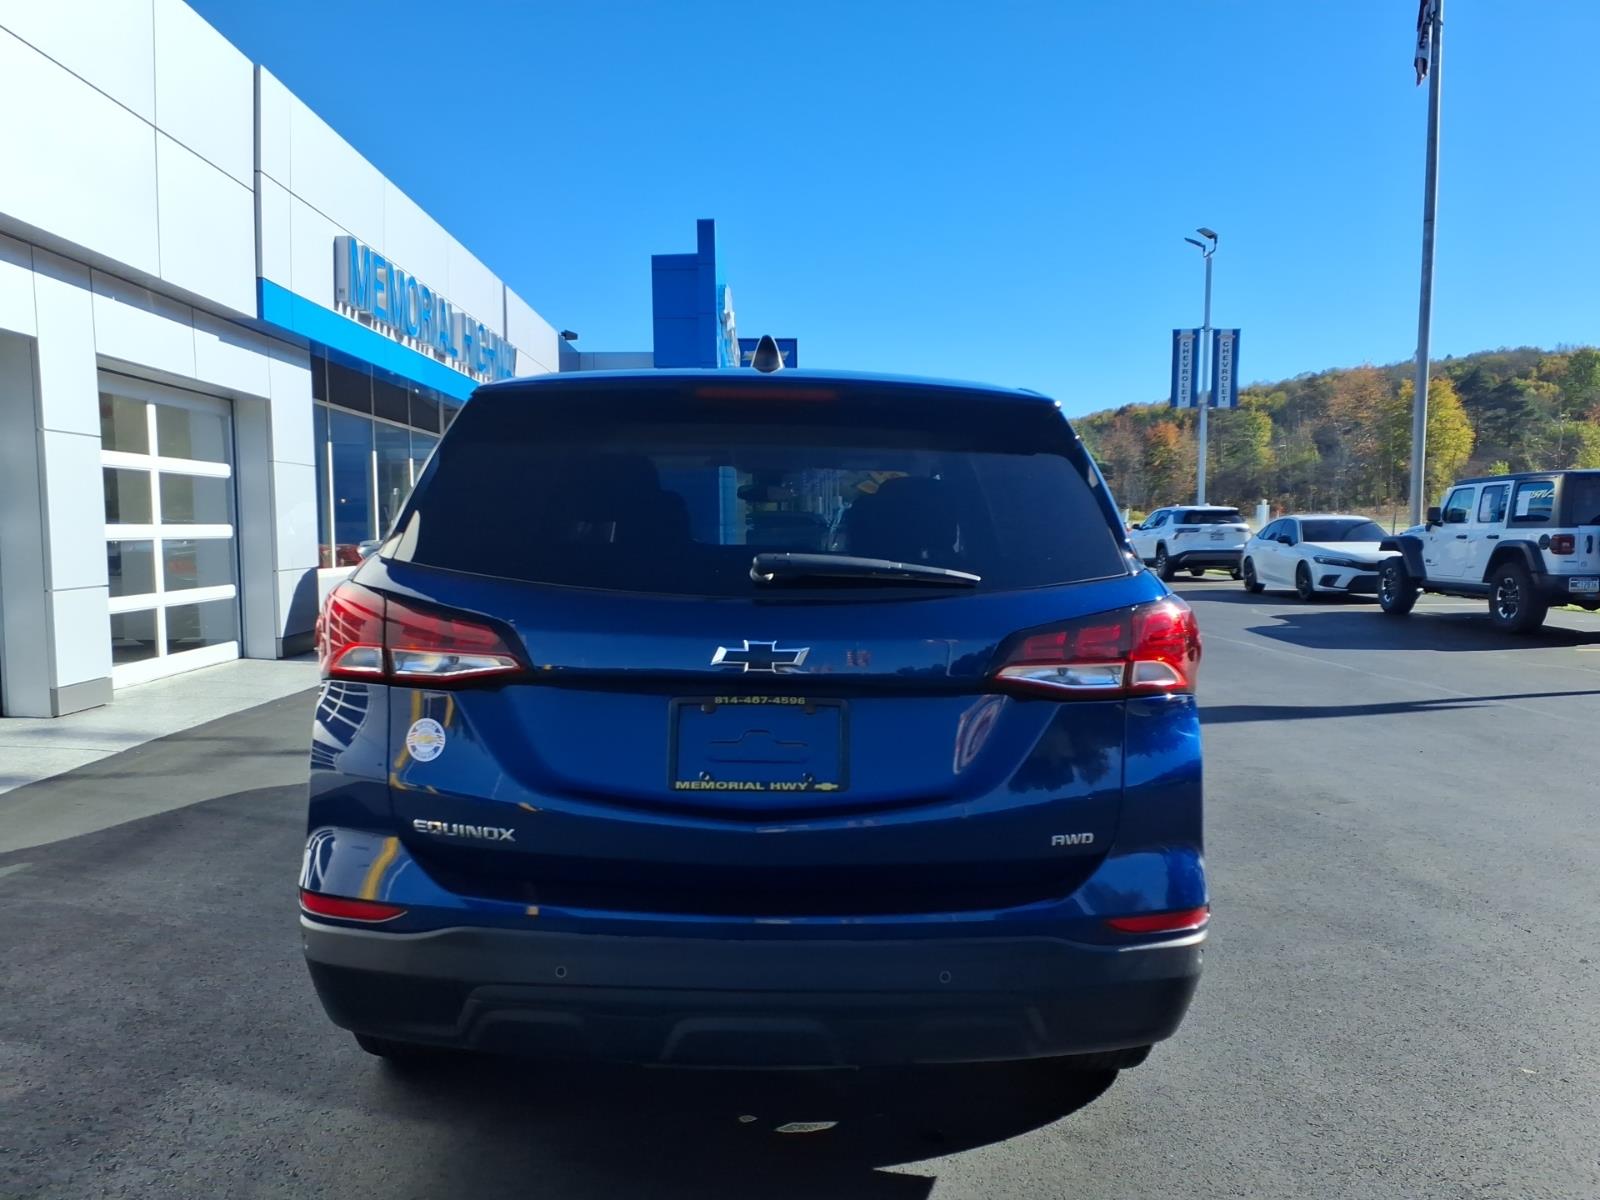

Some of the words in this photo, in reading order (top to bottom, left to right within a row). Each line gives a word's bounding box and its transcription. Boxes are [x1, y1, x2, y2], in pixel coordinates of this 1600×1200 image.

[334, 235, 459, 359] MEMORIAL
[1181, 341, 1191, 402] CHEVROLET
[1221, 341, 1230, 402] CHEVROLET
[675, 781, 765, 790] MEMORIAL
[770, 782, 808, 790] HWY
[413, 818, 516, 842] EQUINOX
[1051, 832, 1095, 846] AWD
